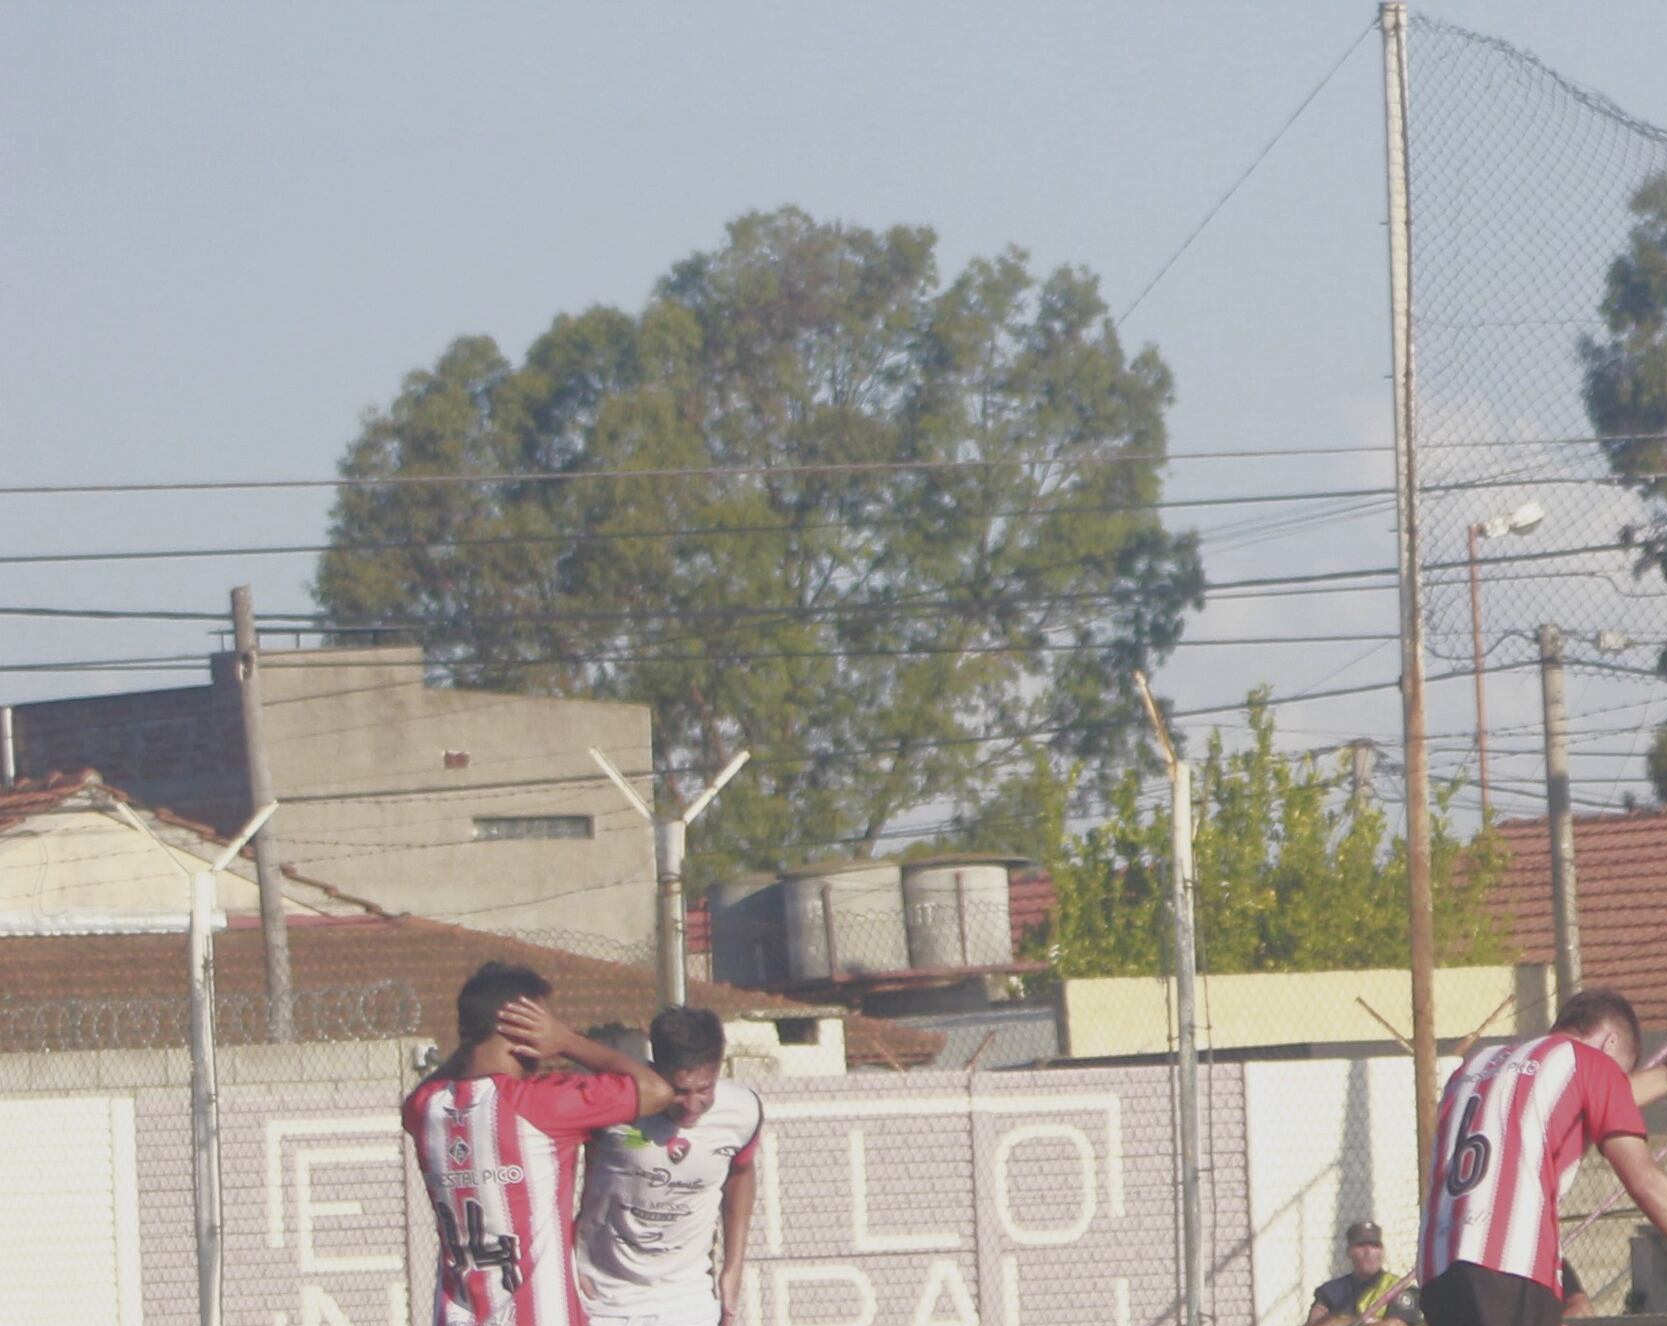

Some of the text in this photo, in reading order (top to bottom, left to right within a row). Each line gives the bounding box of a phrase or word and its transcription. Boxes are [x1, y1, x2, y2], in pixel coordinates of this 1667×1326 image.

[482, 1165, 524, 1183] PICO
[1447, 1093, 1493, 1198] 6
[437, 1199, 524, 1303] 14
